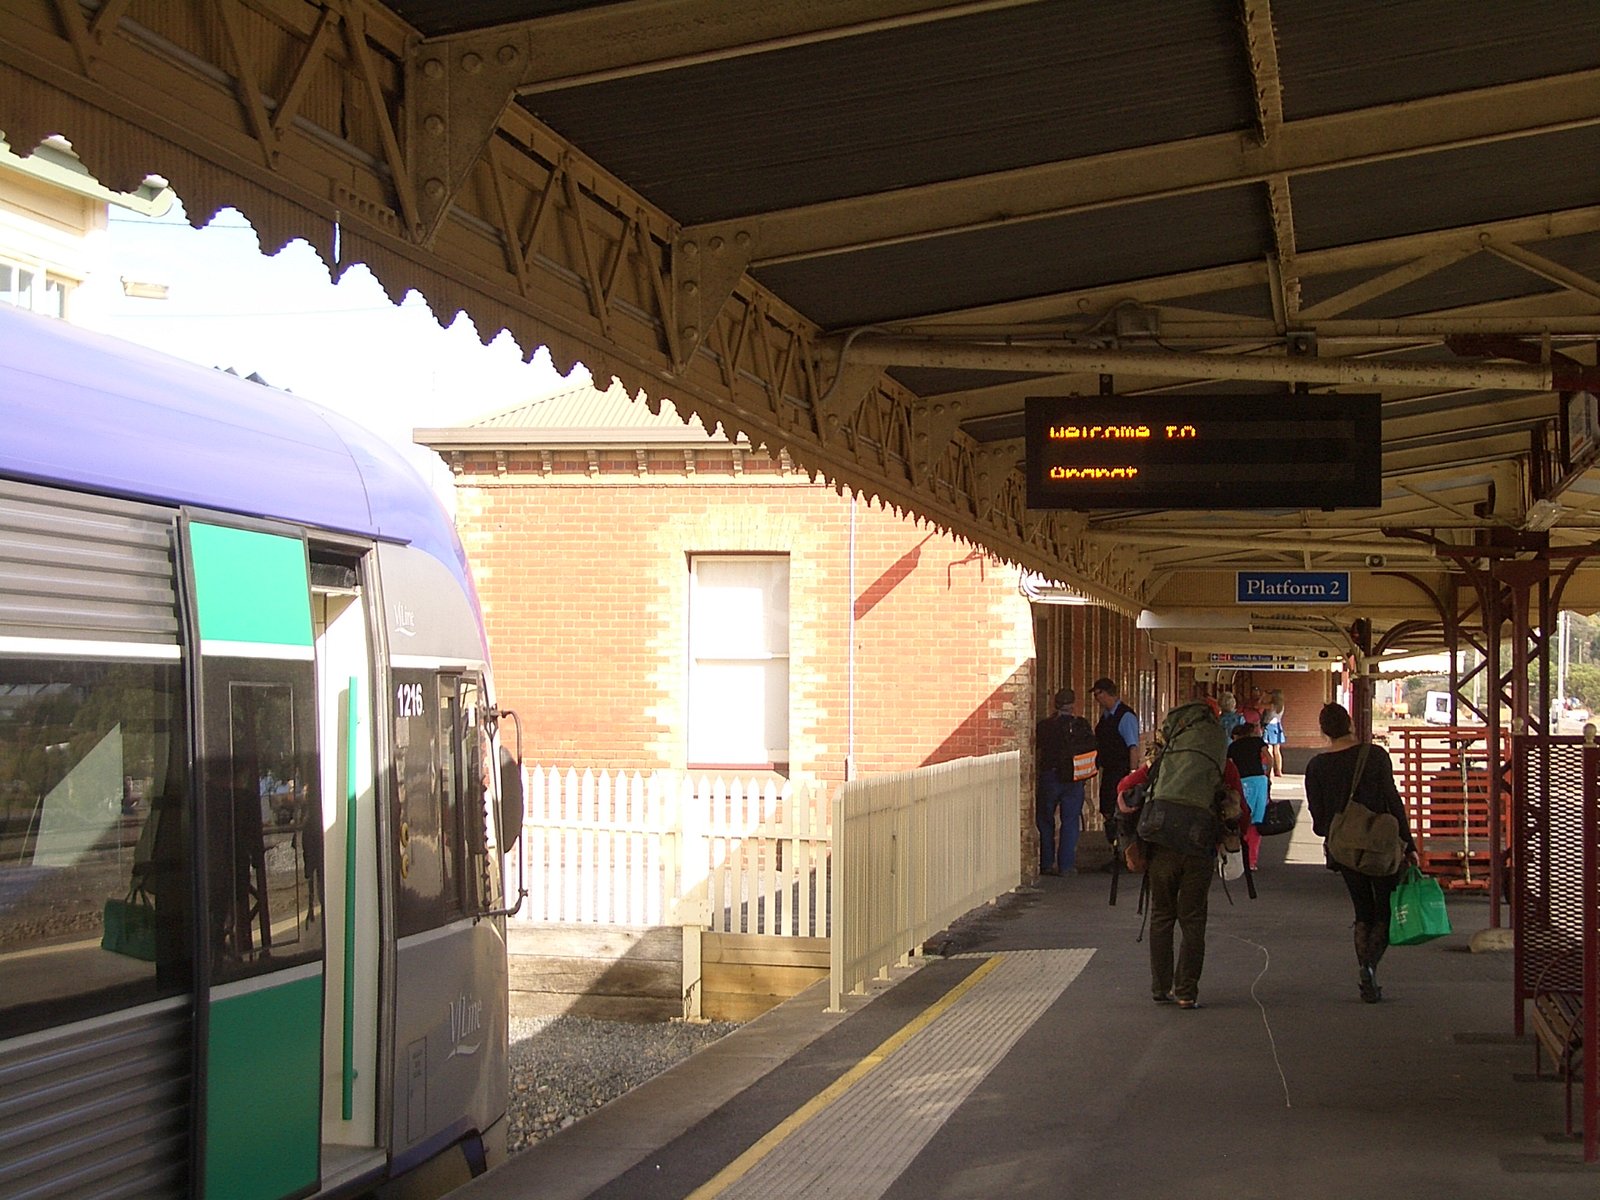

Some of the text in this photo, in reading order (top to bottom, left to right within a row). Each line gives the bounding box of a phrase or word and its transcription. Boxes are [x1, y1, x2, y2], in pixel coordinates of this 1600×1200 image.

[1246, 579, 1340, 595] Platform 2
[397, 683, 423, 716] 1216
